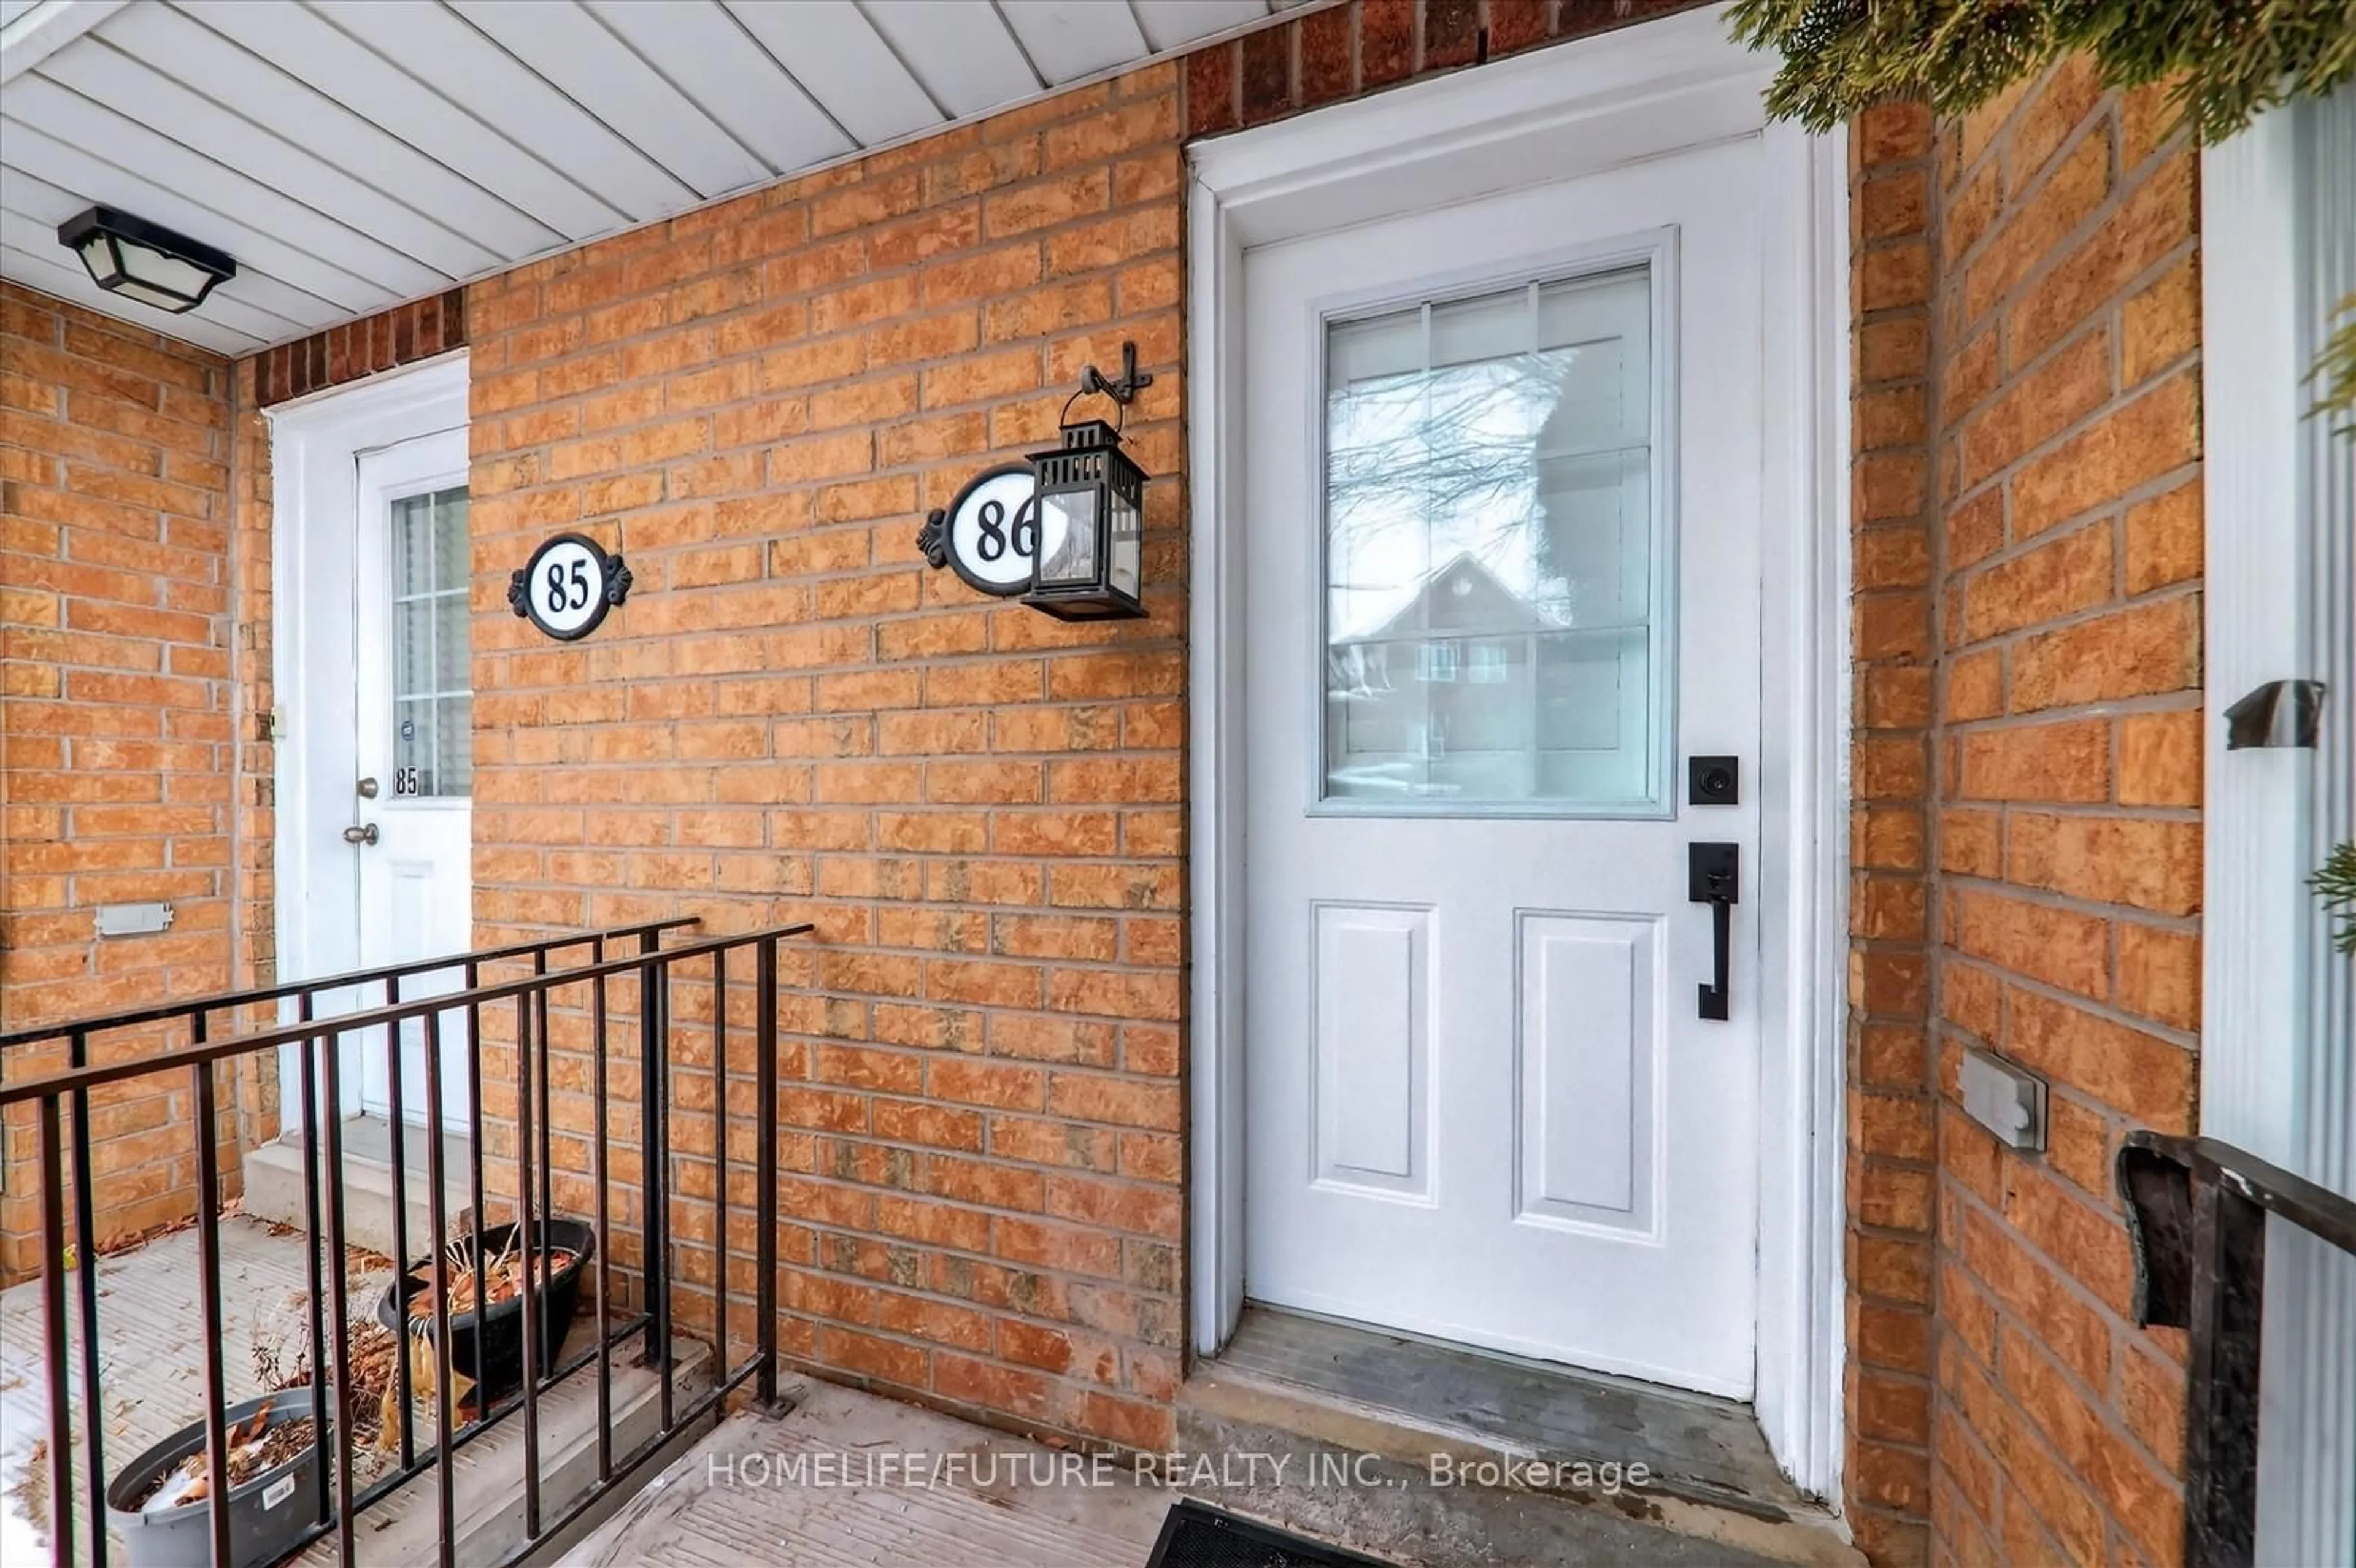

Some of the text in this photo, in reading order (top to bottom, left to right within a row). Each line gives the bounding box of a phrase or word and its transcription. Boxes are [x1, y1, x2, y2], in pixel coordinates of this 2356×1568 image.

[977, 495, 1035, 561] 86
[547, 559, 588, 612] 85
[396, 768, 417, 794] 85
